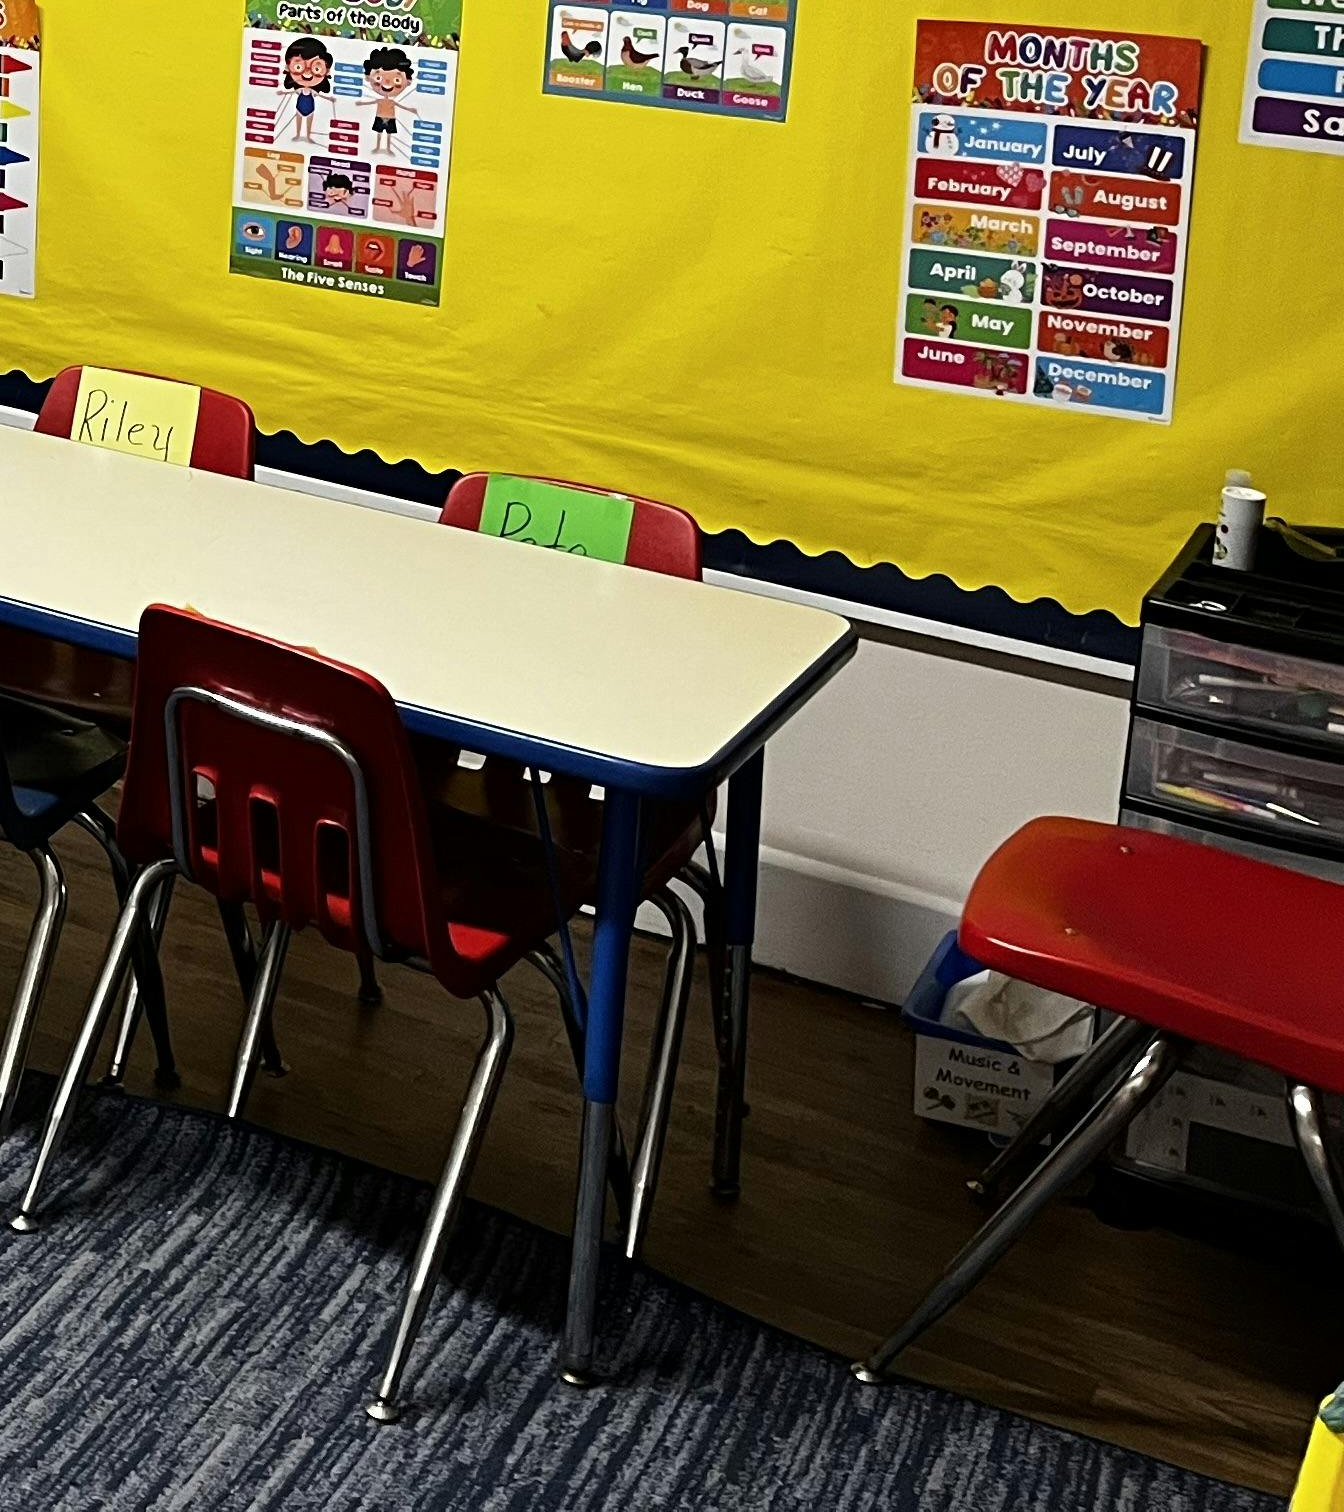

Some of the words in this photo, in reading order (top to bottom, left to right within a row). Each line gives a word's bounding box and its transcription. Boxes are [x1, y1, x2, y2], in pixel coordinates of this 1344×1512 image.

[687, 0, 709, 12] Dog
[280, 4, 321, 21] Parts
[327, 8, 342, 24] of
[350, 10, 375, 26] the
[382, 14, 419, 32] Body
[986, 32, 1139, 74] MONTHS
[677, 88, 704, 100] Duck
[733, 95, 768, 107] Goose
[934, 64, 985, 96] OF
[1001, 70, 1071, 105] THE
[1082, 76, 1177, 117] YEAR
[965, 136, 1043, 159] January
[1063, 145, 1106, 165] July
[928, 177, 1011, 200] February
[1093, 189, 1168, 213] August
[971, 215, 1033, 235] March
[1051, 236, 1160, 263] September
[281, 267, 304, 281] The
[307, 273, 334, 287] Five
[338, 277, 384, 294] Senses
[929, 263, 976, 284] April
[1082, 284, 1164, 306] October
[971, 314, 1014, 336] May
[1048, 316, 1154, 342] November
[918, 346, 965, 364] June
[1048, 363, 1152, 390] December
[79, 390, 175, 461] Riley
[949, 1048, 1001, 1071] Music
[1008, 1061, 1020, 1075] &
[936, 1068, 1031, 1101] Movement
